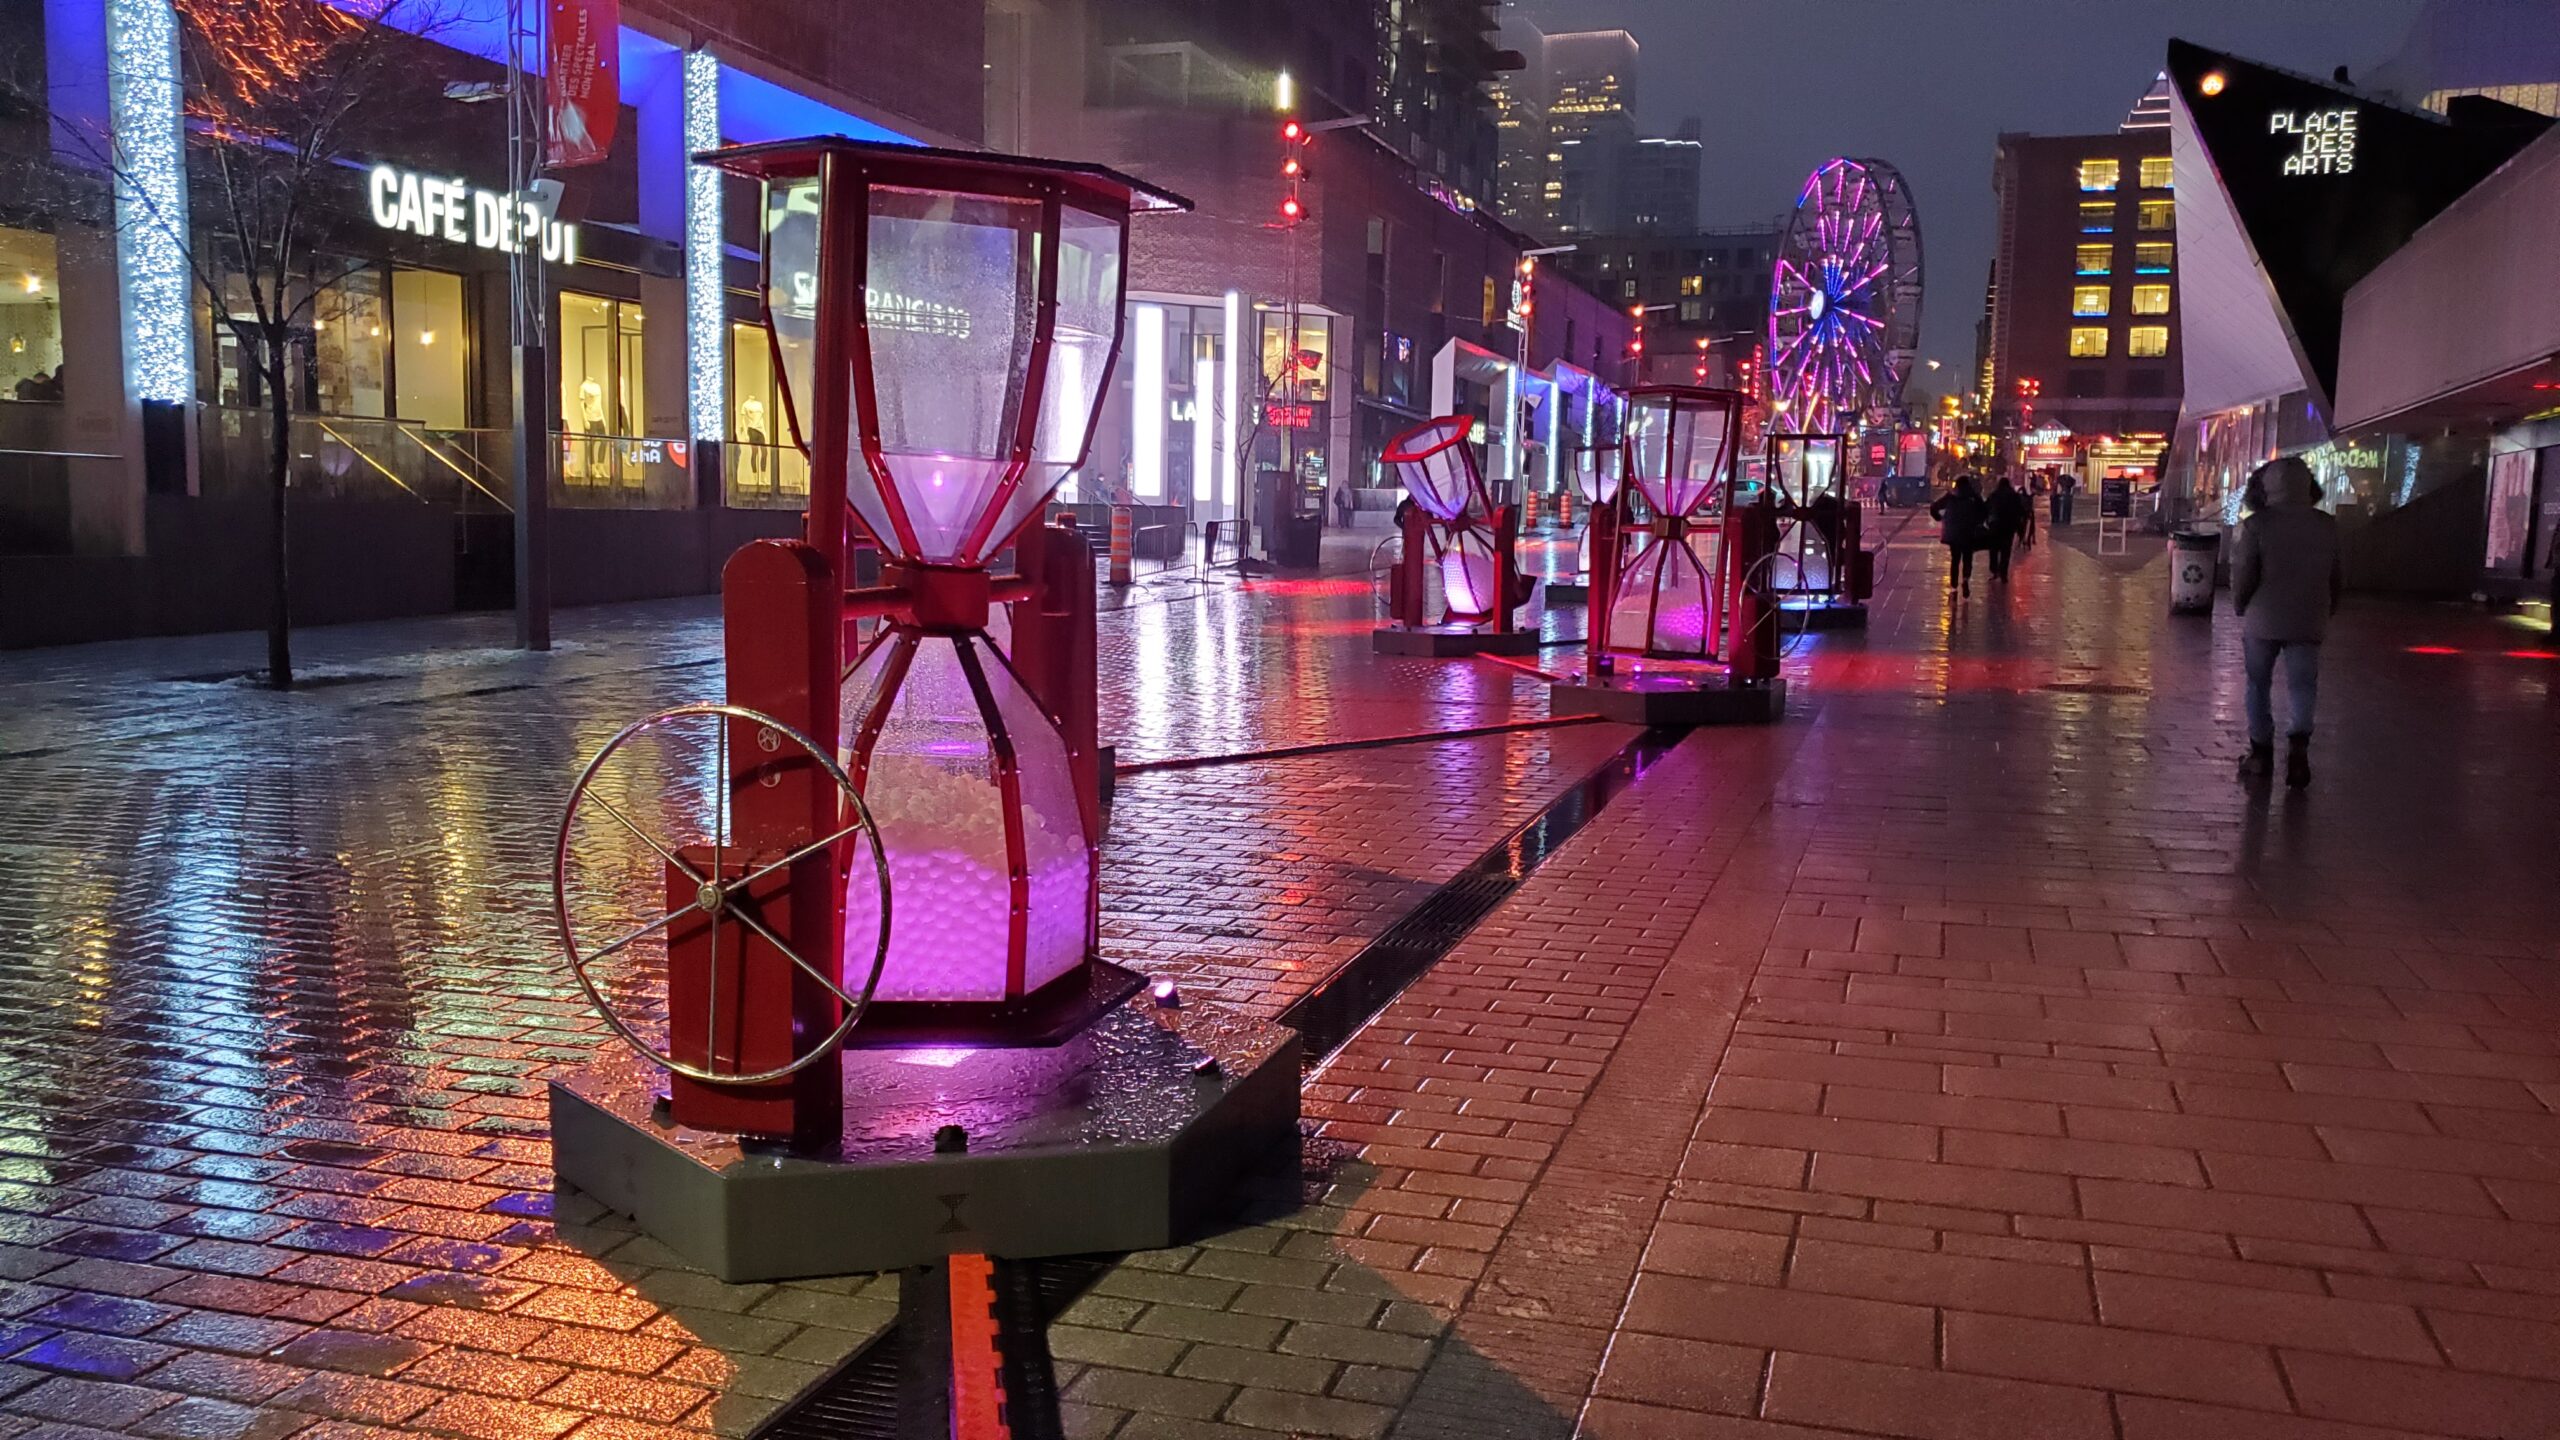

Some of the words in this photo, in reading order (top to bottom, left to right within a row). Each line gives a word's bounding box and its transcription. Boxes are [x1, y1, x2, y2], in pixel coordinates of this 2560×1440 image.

[571, 8, 588, 75] SPECTACLES
[567, 77, 580, 97] DES
[2270, 110, 2358, 134] PLACE
[2302, 132, 2356, 154] DES
[2283, 153, 2354, 176] ARTS
[370, 165, 467, 244] CAFÉ
